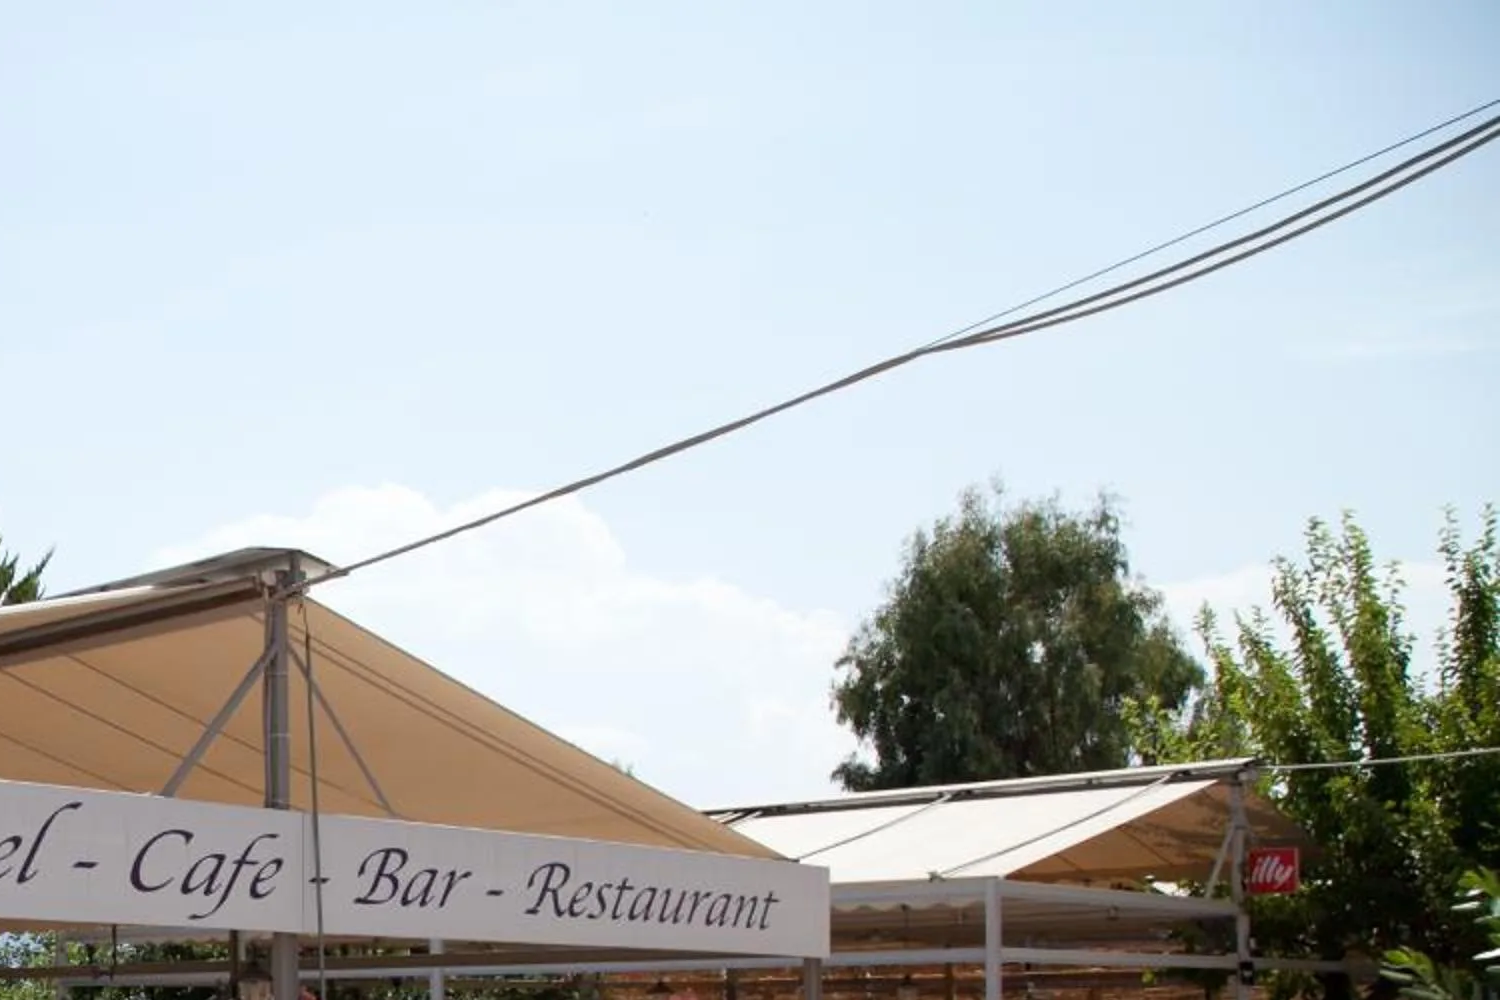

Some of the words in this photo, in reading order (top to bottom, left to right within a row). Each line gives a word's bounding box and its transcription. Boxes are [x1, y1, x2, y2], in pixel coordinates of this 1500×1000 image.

[129, 829, 284, 920] Cafe
[353, 847, 473, 908] Bar
[524, 862, 780, 930] Restaurant
[1251, 856, 1294, 888] illy
